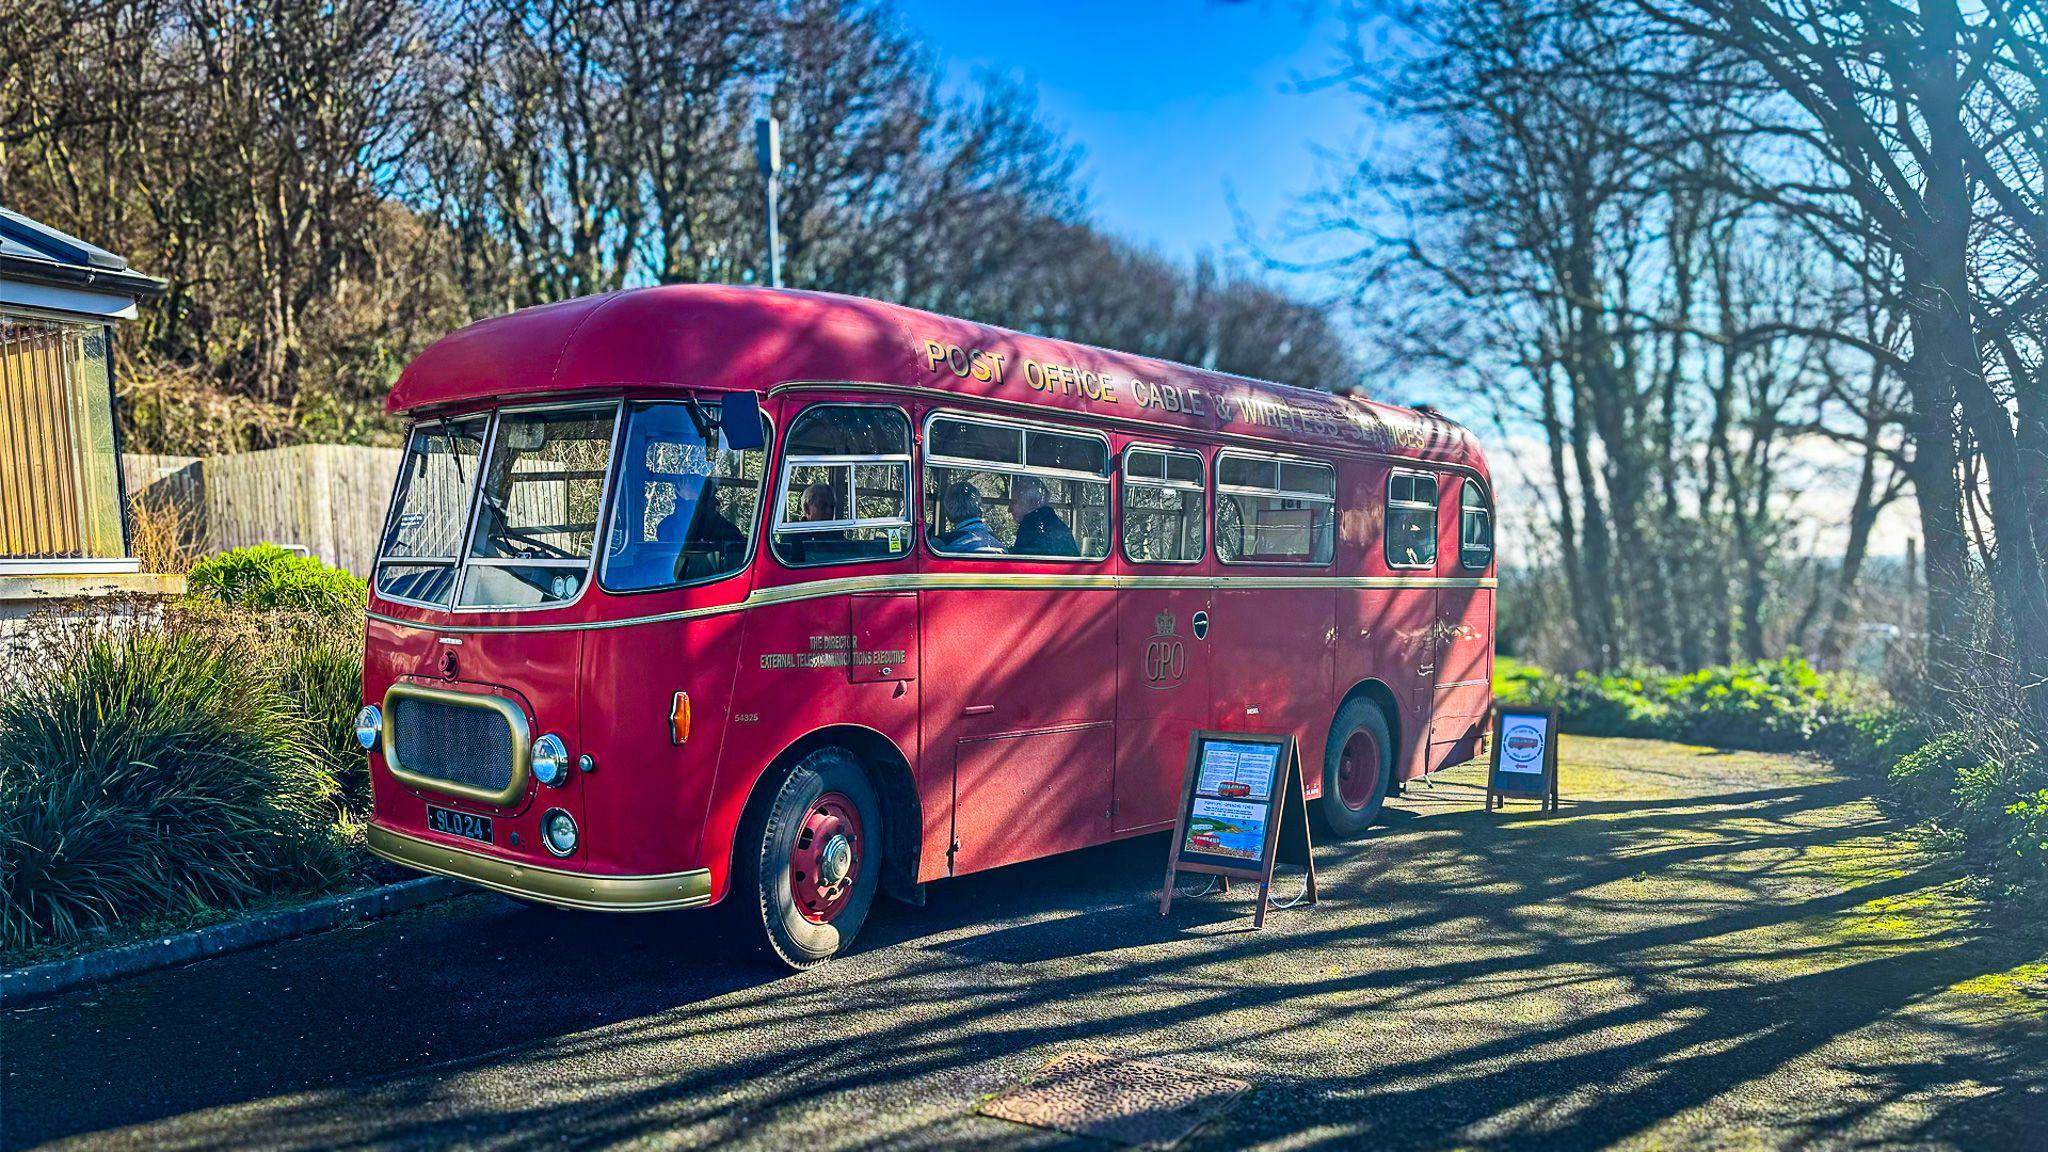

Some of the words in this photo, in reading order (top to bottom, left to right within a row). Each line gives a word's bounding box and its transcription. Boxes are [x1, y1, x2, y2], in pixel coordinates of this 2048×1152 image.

[922, 339, 1005, 385] POST
[1022, 359, 1118, 403] OFFICE
[1130, 379, 1205, 416] CABLE
[1215, 394, 1233, 422] &
[1236, 397, 1340, 438] WIRELESS
[809, 636, 823, 650] THE
[824, 635, 858, 650] DIRECTOR
[760, 653, 796, 669] EXTERNAL
[873, 650, 906, 665] EXECUTIVE
[1145, 641, 1186, 681] GPO
[734, 713, 759, 722] 54325
